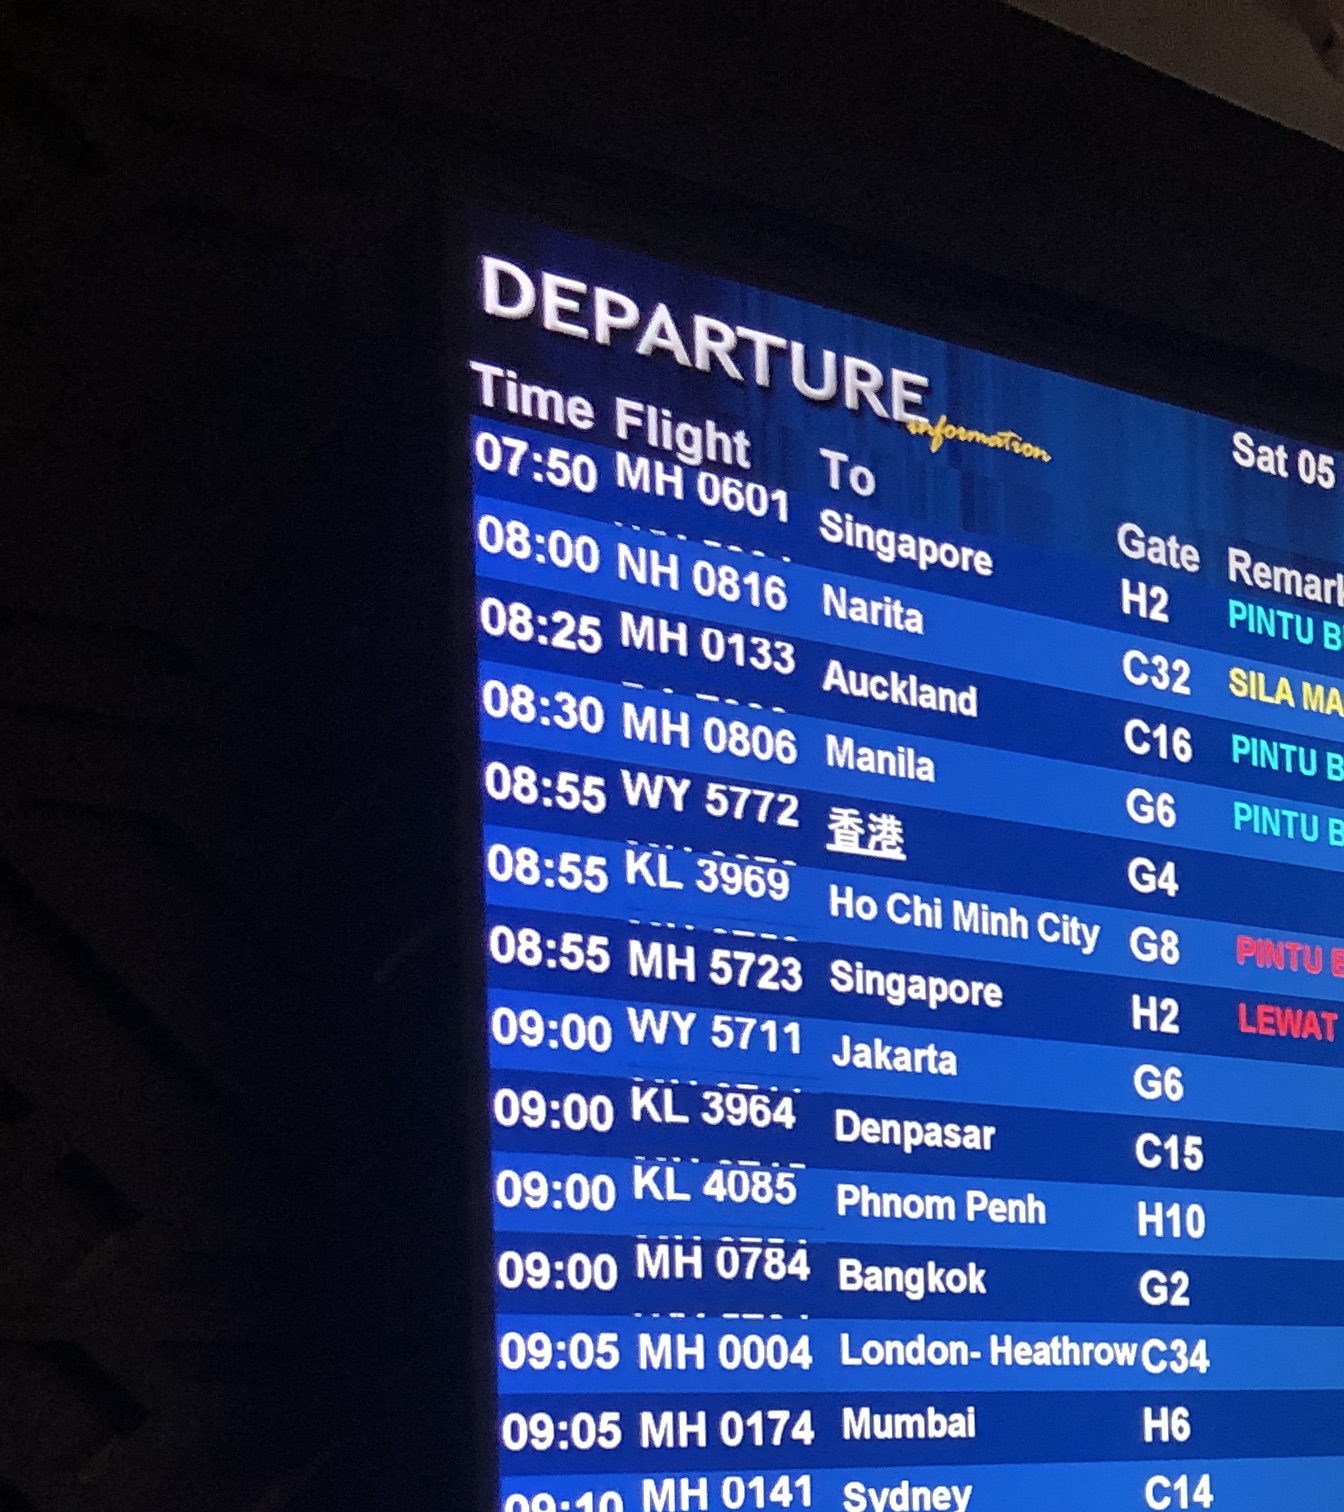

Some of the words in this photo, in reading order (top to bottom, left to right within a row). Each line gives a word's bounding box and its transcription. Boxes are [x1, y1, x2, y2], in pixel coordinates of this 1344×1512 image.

[483, 255, 930, 424] DEPARTURE
[468, 360, 594, 430] Time
[615, 396, 751, 469] Flight
[819, 447, 876, 496] To
[1117, 522, 1200, 572] Gate
[905, 414, 1052, 463] information
[1232, 431, 1289, 478] Sat
[1297, 449, 1336, 489] 05
[475, 431, 598, 493] 07:50
[615, 451, 684, 500] MH
[697, 471, 788, 523] 0601
[819, 508, 993, 576] Singapore
[1121, 578, 1169, 623] H2
[1228, 599, 1314, 645] PINTU
[478, 514, 600, 573] 08:00
[617, 542, 679, 591] NH
[692, 560, 788, 611] 0816
[823, 583, 924, 635] Narita
[1122, 649, 1191, 696] C32
[1229, 666, 1295, 708] SILA
[480, 596, 602, 654] 08:25
[620, 611, 688, 657] MH
[701, 627, 795, 675] 0133
[822, 659, 978, 717] Auckland
[1124, 718, 1192, 763] C16
[1232, 734, 1317, 776] PINTU
[485, 761, 606, 814] 08:55
[621, 769, 691, 812] WY
[705, 782, 799, 828] 5772
[826, 806, 906, 854] 香港
[487, 843, 609, 893] 08:55
[625, 849, 684, 890] KL
[695, 858, 790, 901] 3969
[830, 884, 878, 921] Ho
[886, 892, 943, 929] Chi
[952, 899, 1029, 940] Minh
[1037, 911, 1101, 955] City
[1129, 926, 1180, 965] G8
[1237, 936, 1322, 973] PINTU
[1128, 857, 1179, 897] G4
[489, 925, 610, 973] 08:55
[629, 939, 696, 982] MH
[709, 948, 803, 992] 5723
[830, 959, 1003, 1010] Singapore
[1132, 994, 1180, 1034] H2
[1239, 1003, 1337, 1040] LEWAT
[491, 1006, 612, 1053] 09:00
[626, 1007, 697, 1046] WY
[711, 1014, 800, 1054] 5711
[831, 1034, 958, 1076] Jakarta
[1133, 1063, 1184, 1102] G6
[495, 1169, 616, 1212] 09:00
[633, 1164, 691, 1201] KL
[702, 1168, 797, 1205] 4085
[837, 1183, 956, 1221] Phnom
[966, 1189, 1047, 1224] Penh
[1138, 1200, 1206, 1239] H10
[498, 1250, 618, 1291] 09:00
[636, 1243, 703, 1279] MH
[716, 1246, 811, 1281] 0784
[839, 1258, 987, 1300] Bangkok
[1139, 1269, 1190, 1306] G2
[499, 1331, 620, 1370] 09:05
[638, 1333, 705, 1370] MH
[718, 1334, 813, 1370] 0004
[840, 1332, 982, 1366] London-
[990, 1334, 1138, 1367] Heathrow
[1142, 1338, 1210, 1373] C34
[502, 1411, 622, 1451] 09:05
[640, 1410, 707, 1448] MH
[720, 1409, 815, 1447] 0174
[842, 1406, 976, 1440] Mumbai
[1143, 1406, 1191, 1442] H6
[721, 1474, 811, 1510] 0141
[1145, 1473, 1214, 1511] C14
